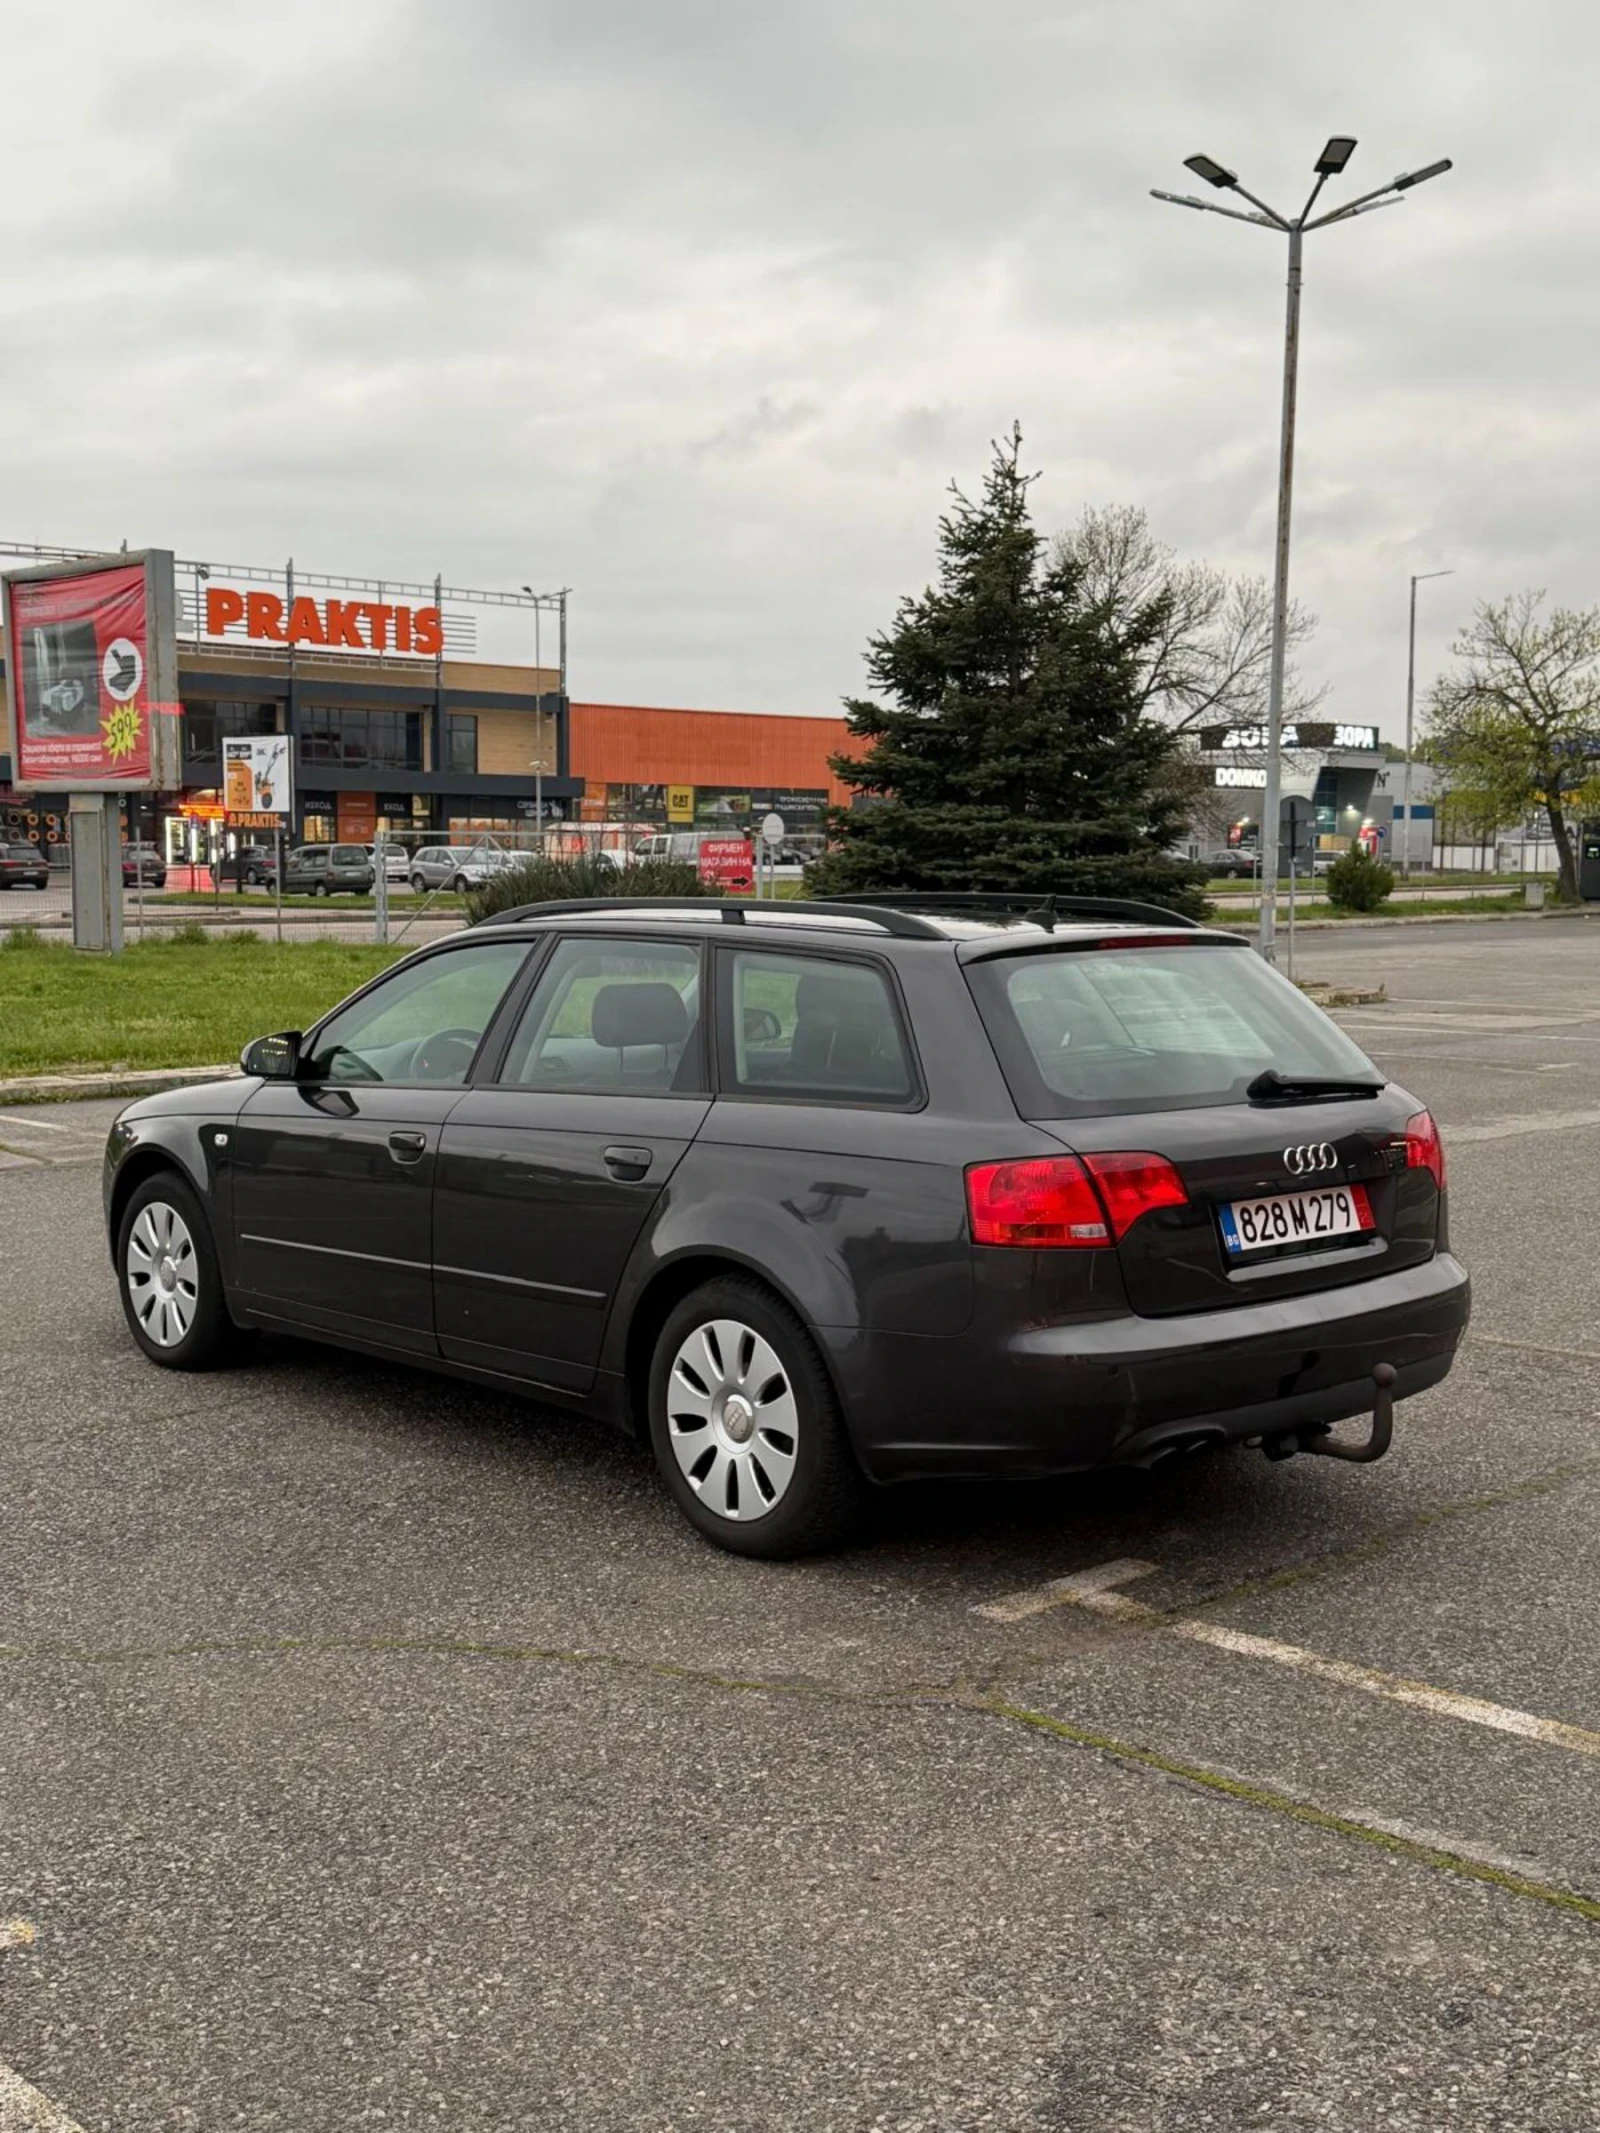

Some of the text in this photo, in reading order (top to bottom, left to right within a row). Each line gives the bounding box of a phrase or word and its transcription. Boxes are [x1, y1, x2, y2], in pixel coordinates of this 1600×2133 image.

[206, 588, 443, 655] PRAKTIS
[1333, 725, 1374, 749] ЗОРА
[672, 794, 689, 808] CAT
[1239, 1202, 1289, 1243] 828
[1308, 1192, 1351, 1233] 279
[1226, 1234, 1240, 1247] BG
